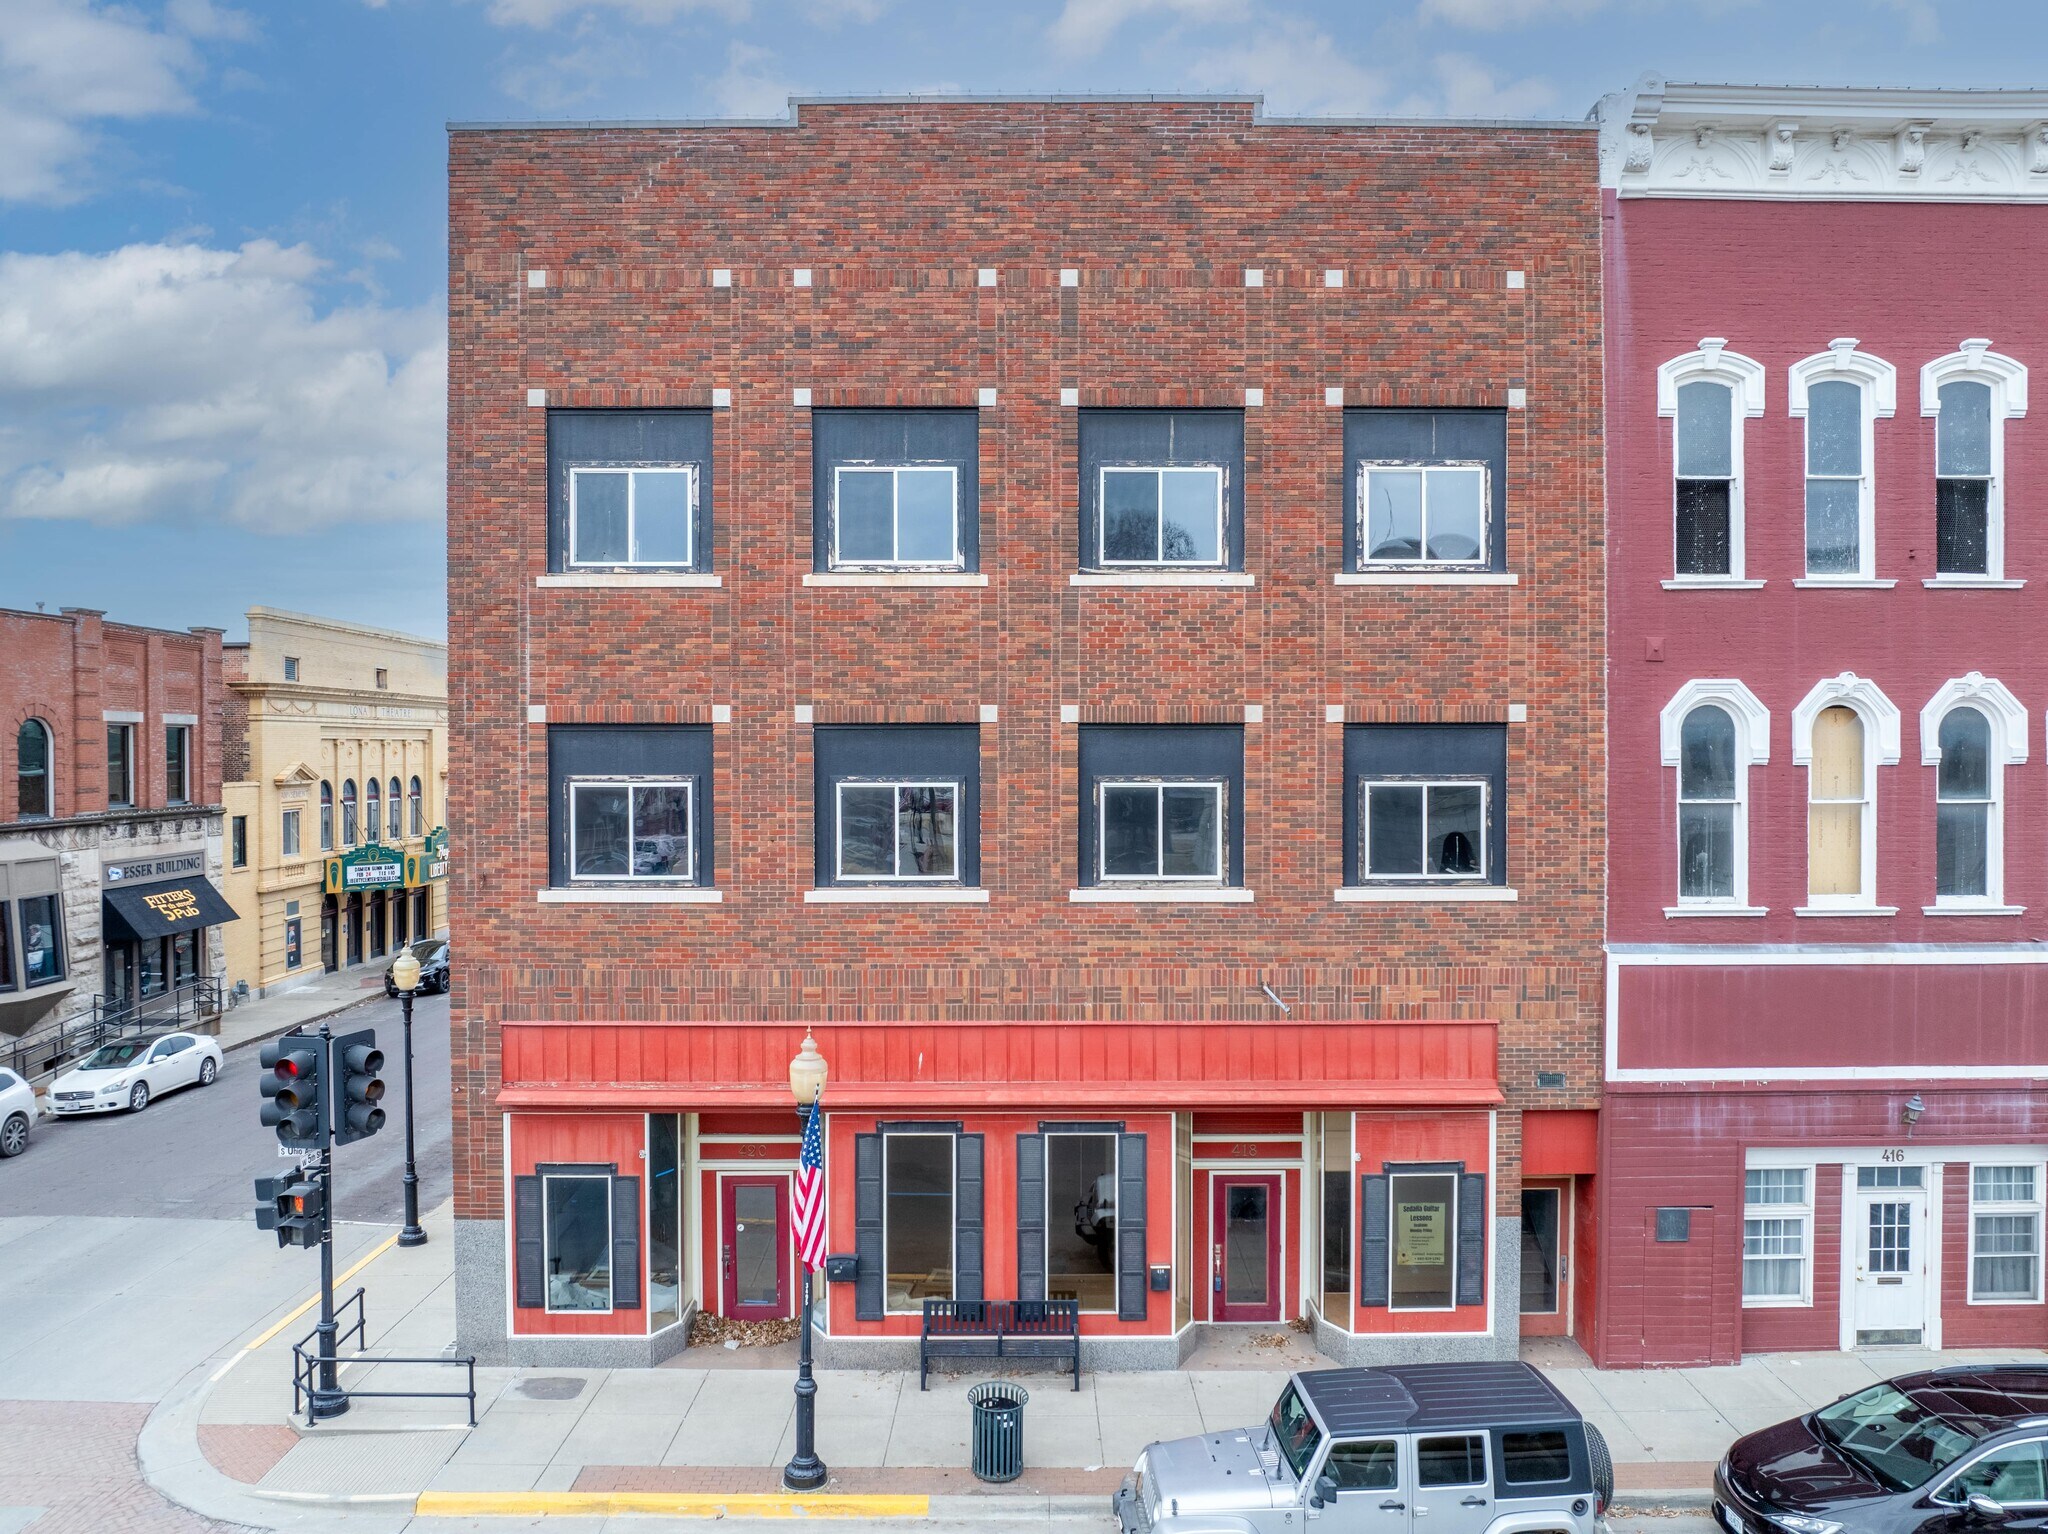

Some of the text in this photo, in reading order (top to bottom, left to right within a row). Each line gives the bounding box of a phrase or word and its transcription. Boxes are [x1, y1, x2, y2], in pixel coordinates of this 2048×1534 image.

[382, 707, 412, 718] THEATRE
[155, 857, 200, 875] BUILDING
[142, 889, 196, 909] FITTERS
[172, 906, 200, 919] Pub
[738, 1144, 767, 1157] 420
[1231, 1143, 1257, 1157] 418
[1881, 1149, 1905, 1162] 416
